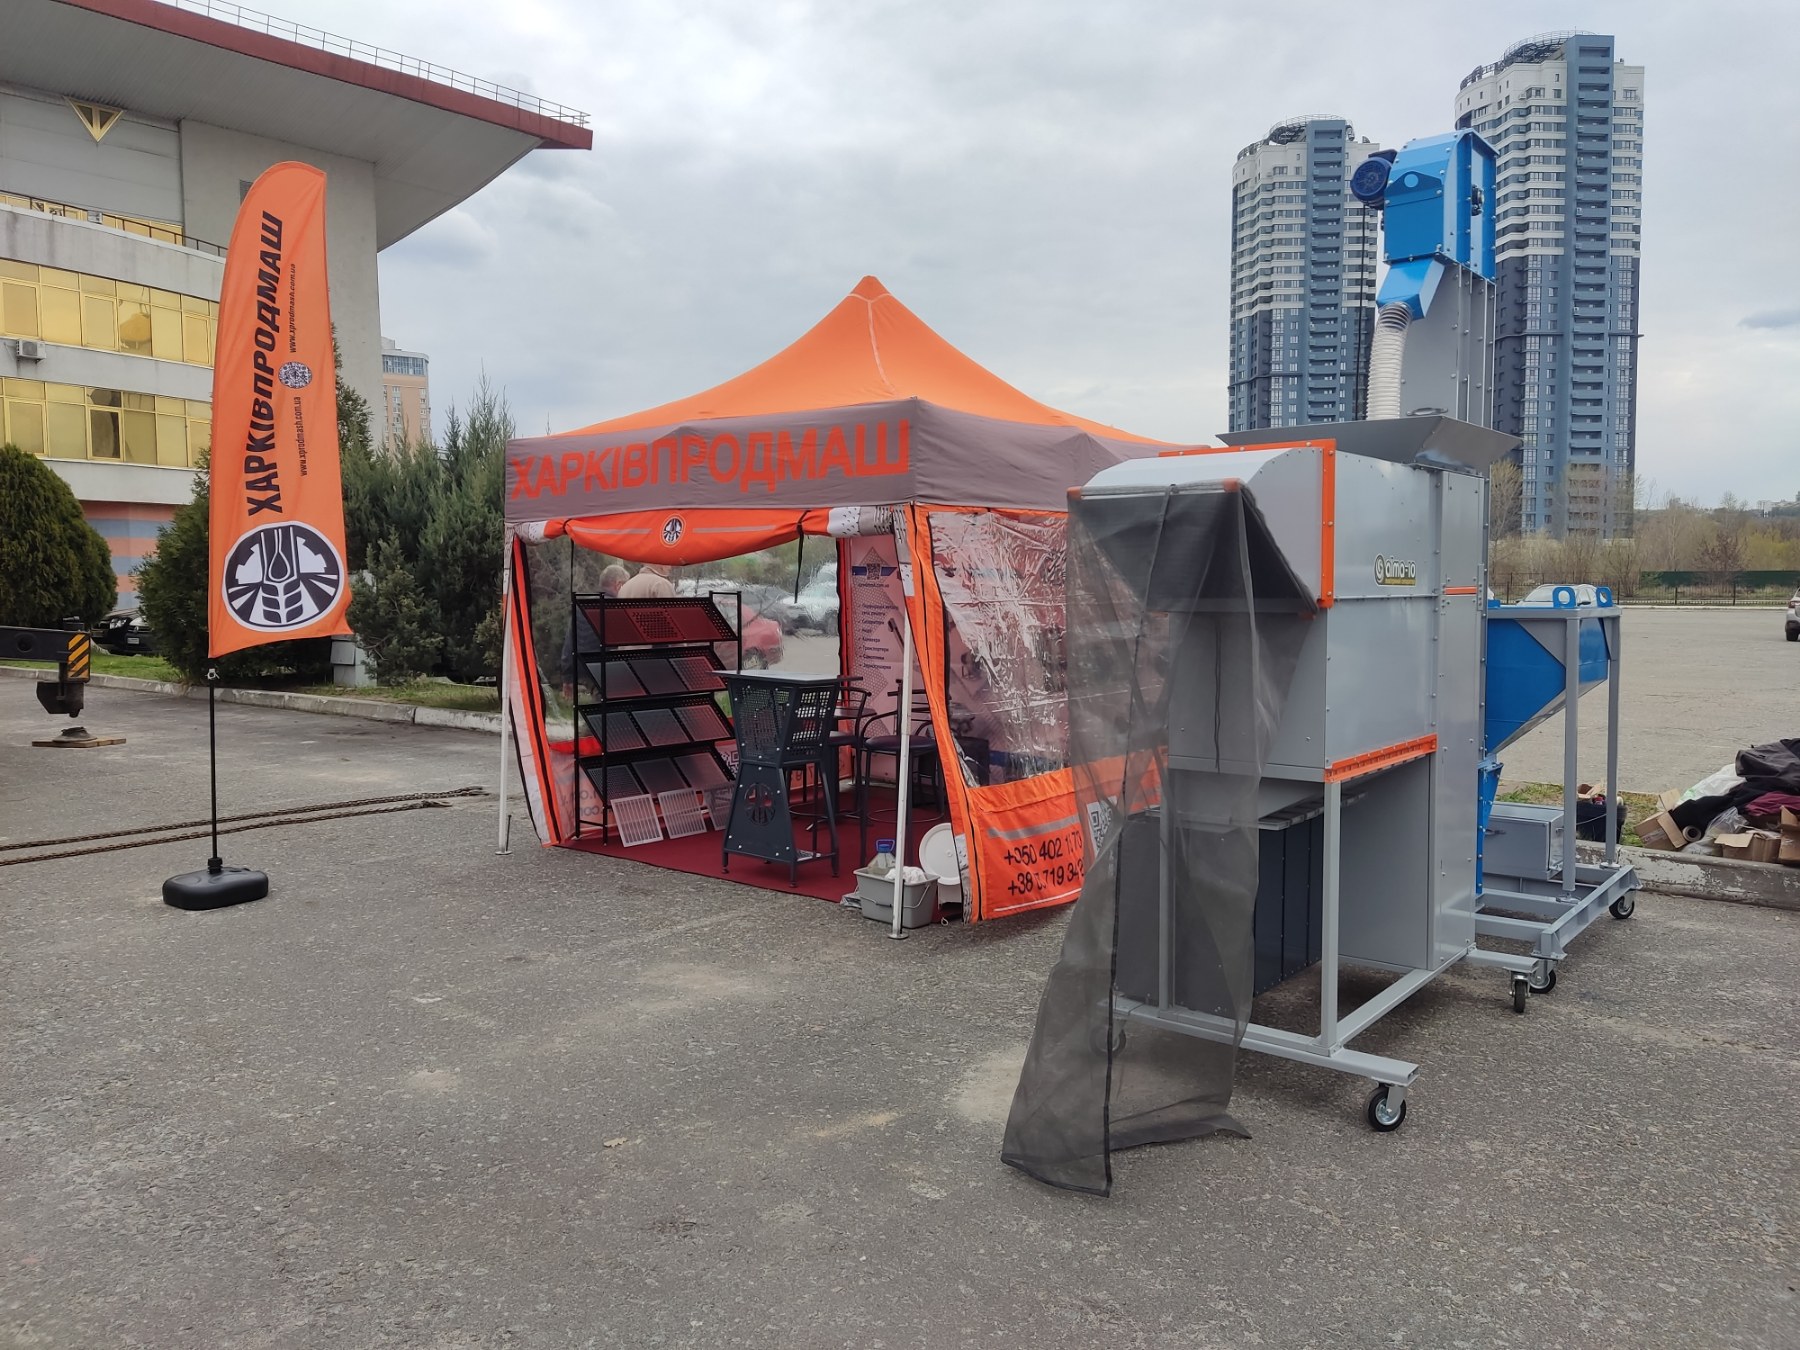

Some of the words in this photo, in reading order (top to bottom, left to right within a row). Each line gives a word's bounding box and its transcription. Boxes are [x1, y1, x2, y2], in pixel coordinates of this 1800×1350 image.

[244, 210, 283, 516] ХАРКІВПРОДМАШ
[294, 396, 308, 476] www.xprodmash.com.ua
[511, 419, 910, 500] ХАРКІВПРОДМАШ
[1008, 871, 1033, 896] +38
[1039, 837, 1063, 860] 402
